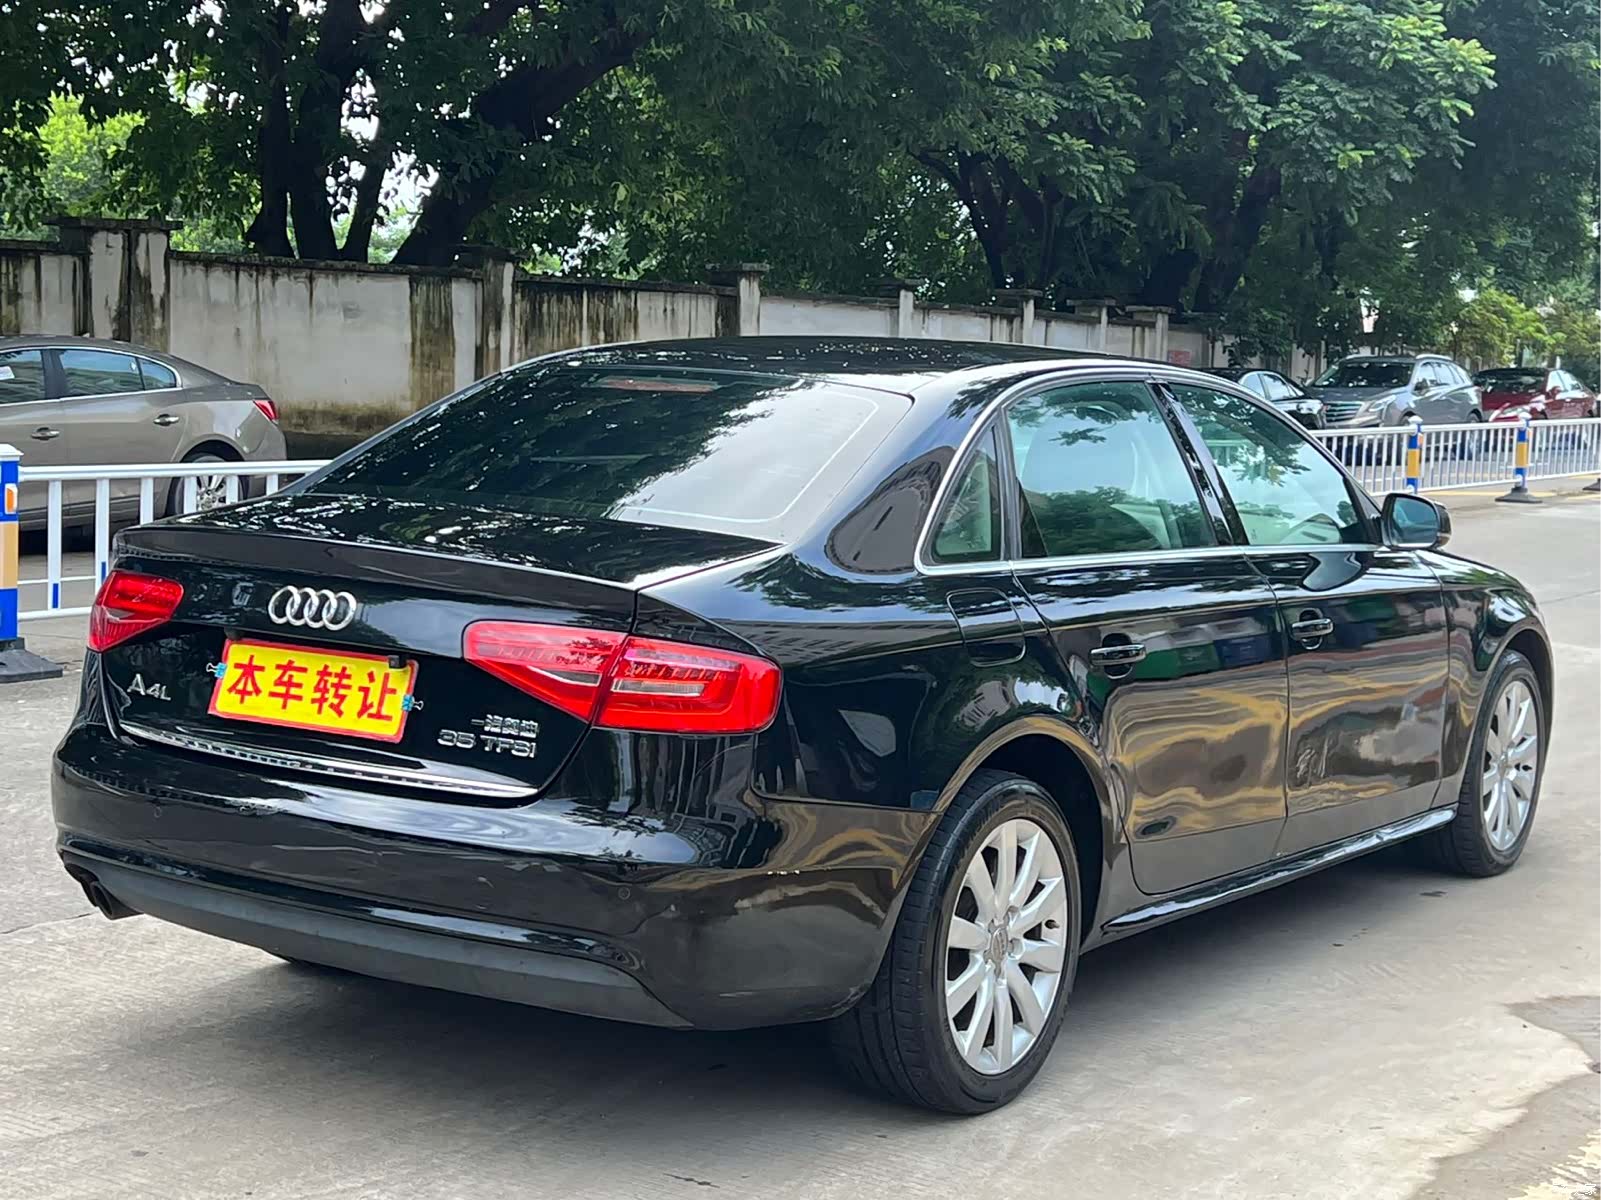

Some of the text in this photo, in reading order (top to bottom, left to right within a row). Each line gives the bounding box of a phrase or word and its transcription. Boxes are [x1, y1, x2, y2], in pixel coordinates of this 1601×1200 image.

[127, 673, 171, 701] A4L
[227, 655, 397, 721] 本车转让
[437, 729, 537, 758] 35 TFSI
